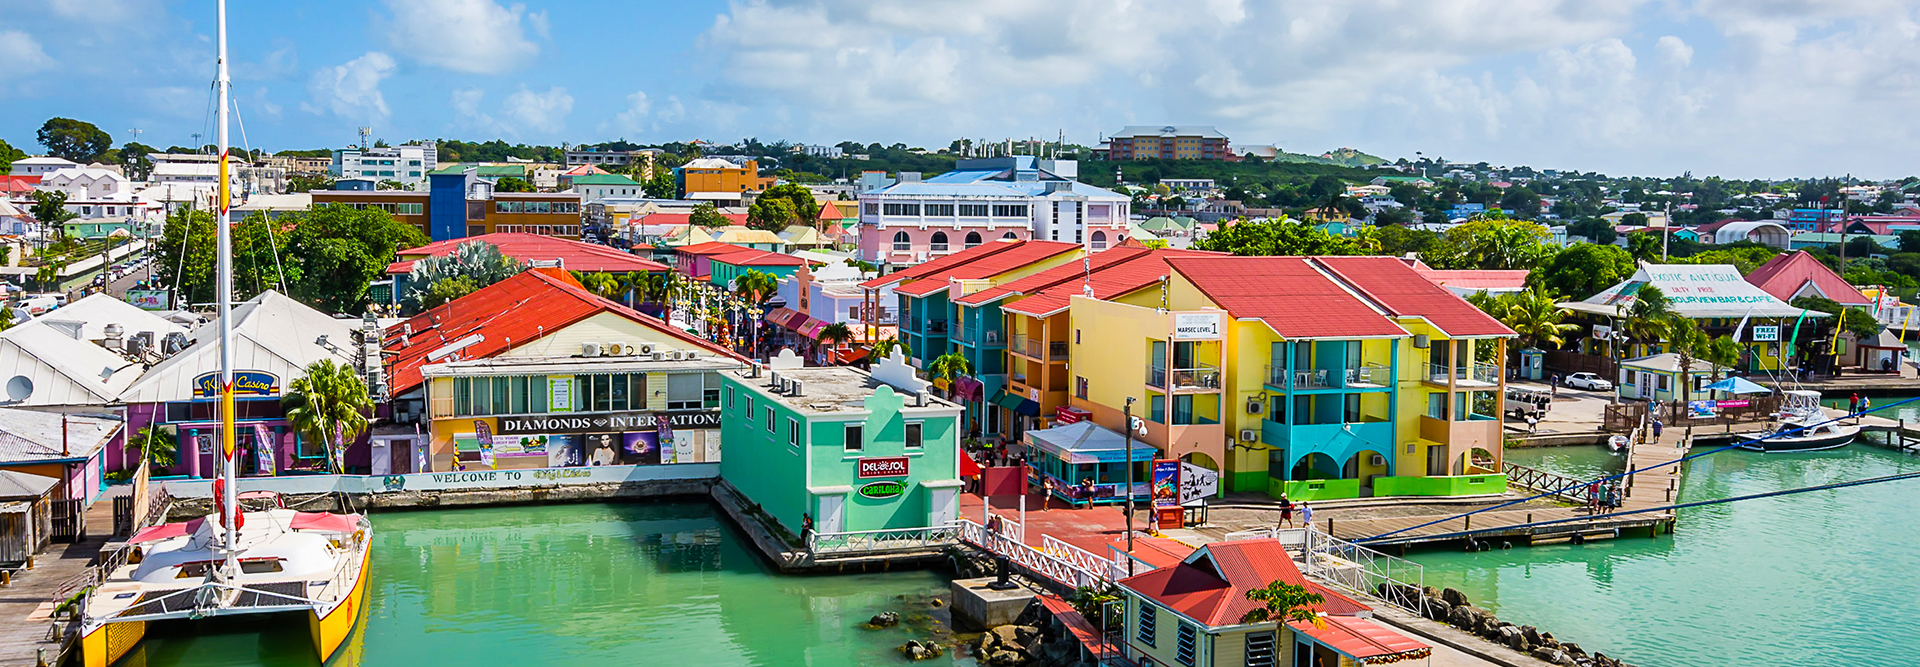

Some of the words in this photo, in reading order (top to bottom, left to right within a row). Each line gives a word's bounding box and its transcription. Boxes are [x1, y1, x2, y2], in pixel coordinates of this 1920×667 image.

[1652, 273, 1685, 282] EXOTIC
[1689, 273, 1739, 282] ANTIGUA
[1211, 322, 1218, 335] 1
[236, 375, 270, 390] Casino
[504, 417, 592, 431] DIAMONDS
[609, 413, 722, 428] INTERATIONA
[863, 463, 877, 471] DEL
[889, 462, 905, 470] SOL
[432, 473, 498, 483] WELCOME
[505, 472, 521, 481] TO
